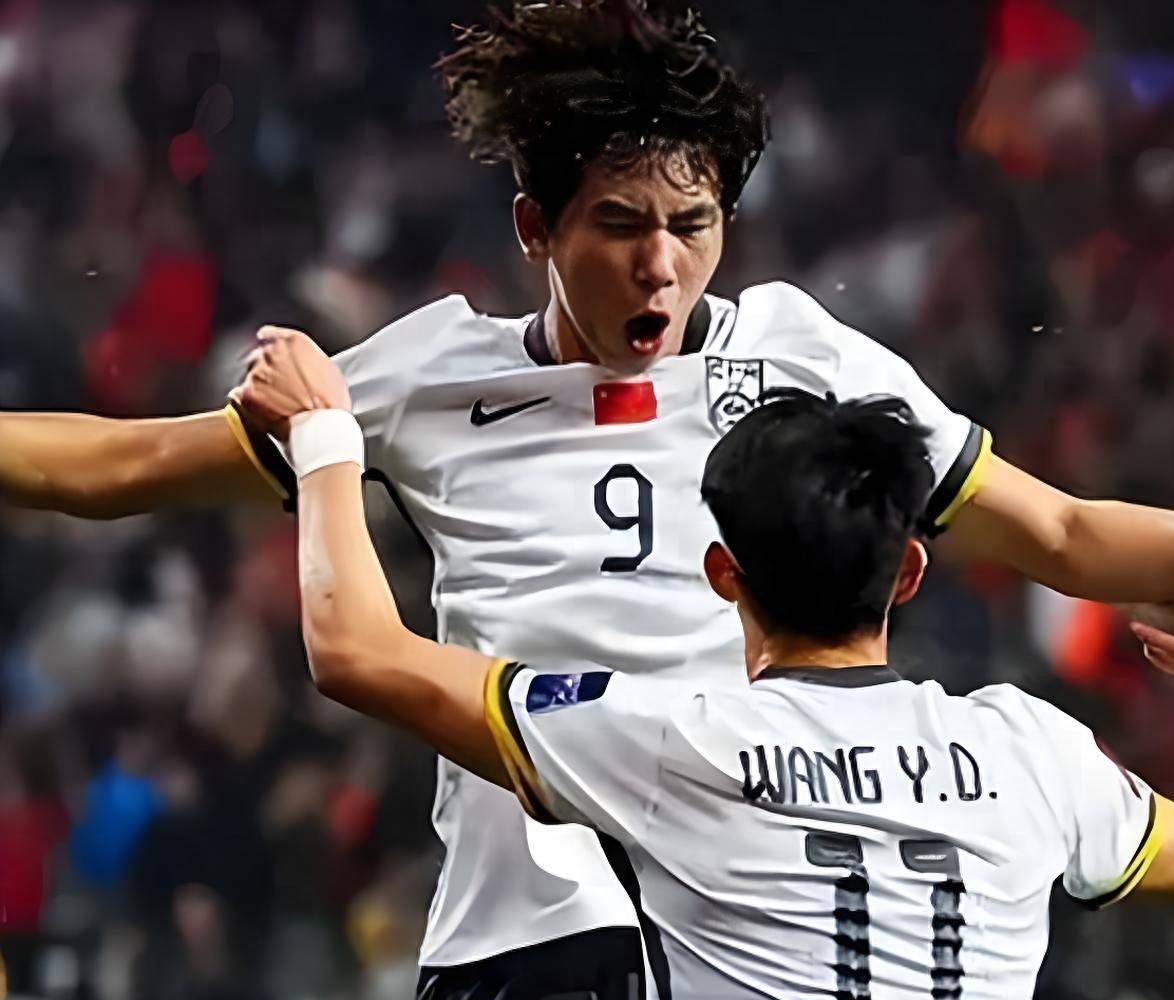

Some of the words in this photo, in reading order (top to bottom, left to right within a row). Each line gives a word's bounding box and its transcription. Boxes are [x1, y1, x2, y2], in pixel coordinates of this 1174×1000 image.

[593, 463, 654, 573] 9
[739, 744, 882, 803] WANG
[897, 742, 997, 803] Y.D.
